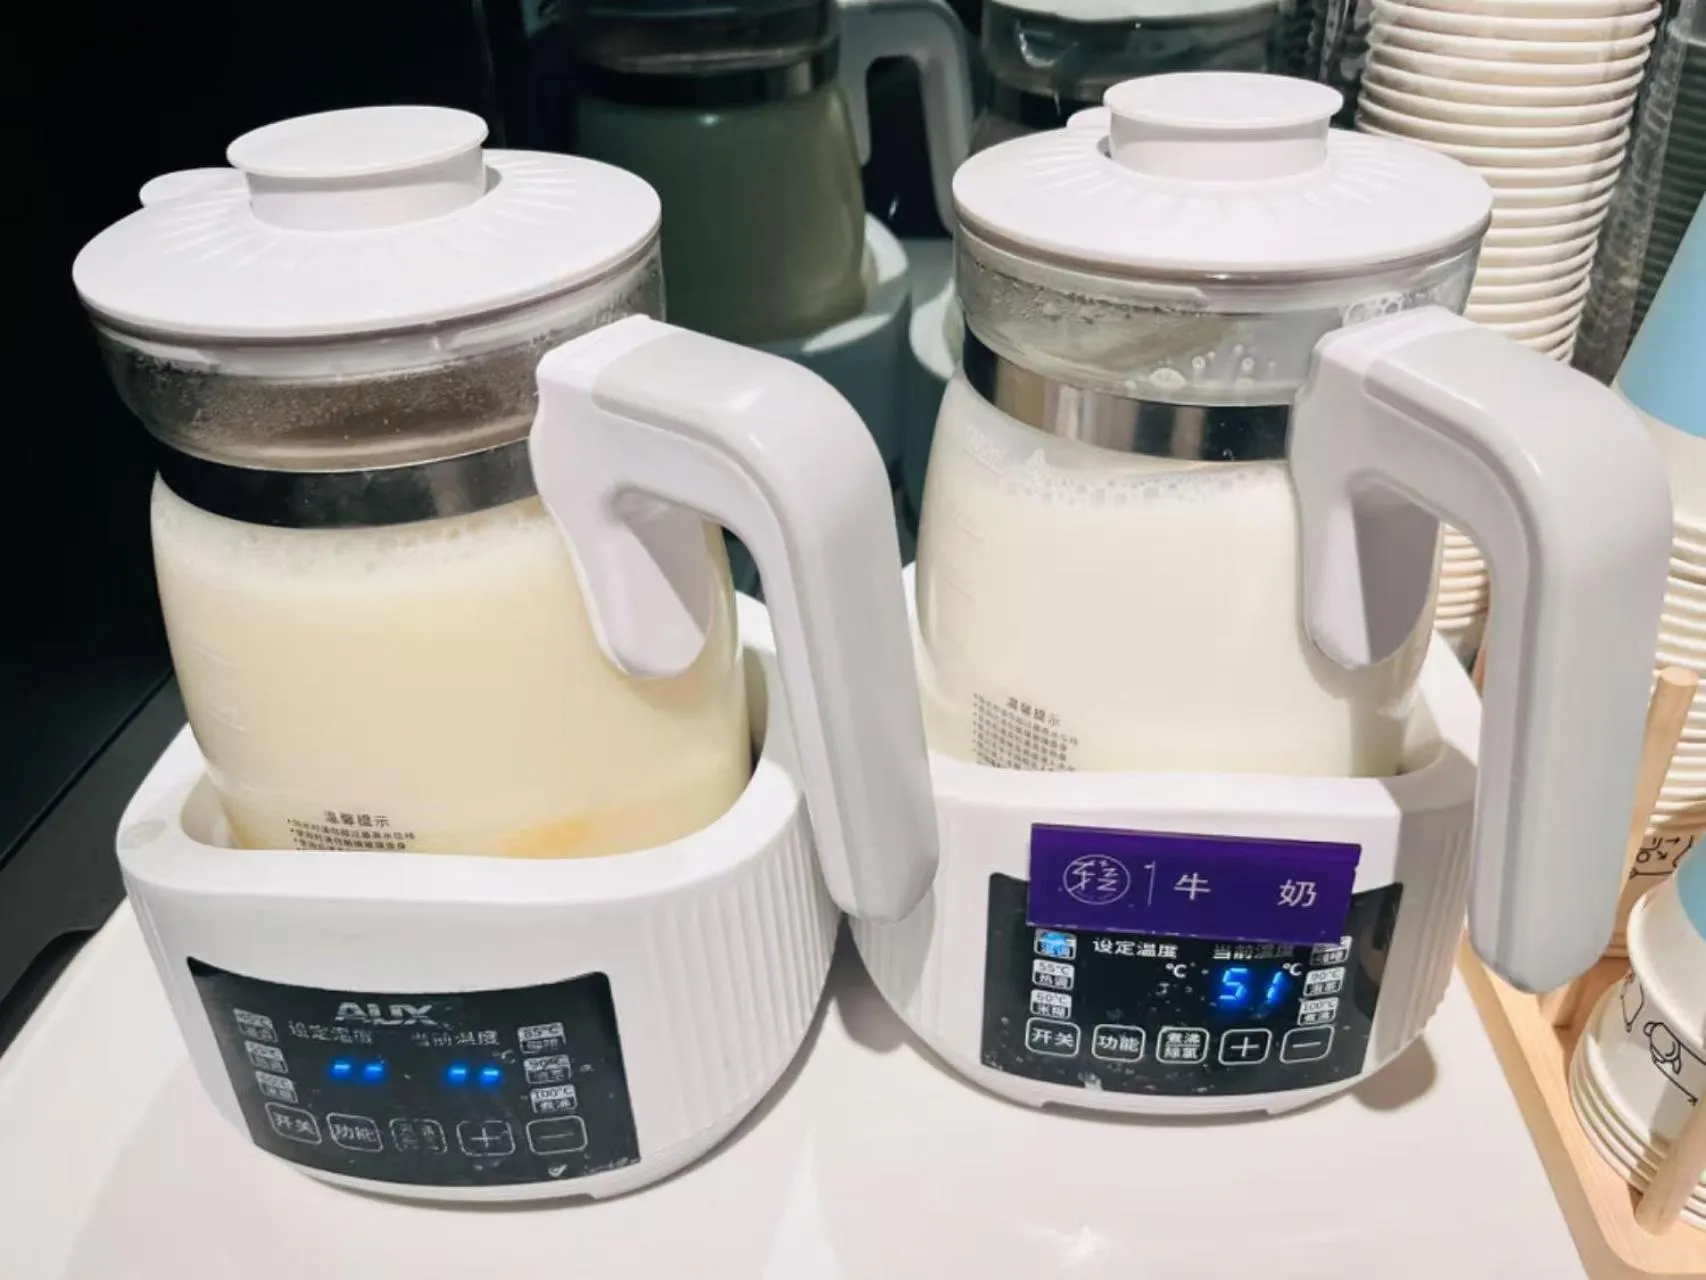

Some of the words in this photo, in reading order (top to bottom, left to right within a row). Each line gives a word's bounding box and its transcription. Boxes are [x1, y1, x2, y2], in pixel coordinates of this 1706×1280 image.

[1091, 938, 1179, 959] 设定温度
[1218, 967, 1283, 1004] 51
[335, 1002, 438, 1026] AUX
[1031, 1026, 1075, 1048] 开关
[1097, 1032, 1140, 1053] 功能
[333, 1122, 378, 1142] 功能
